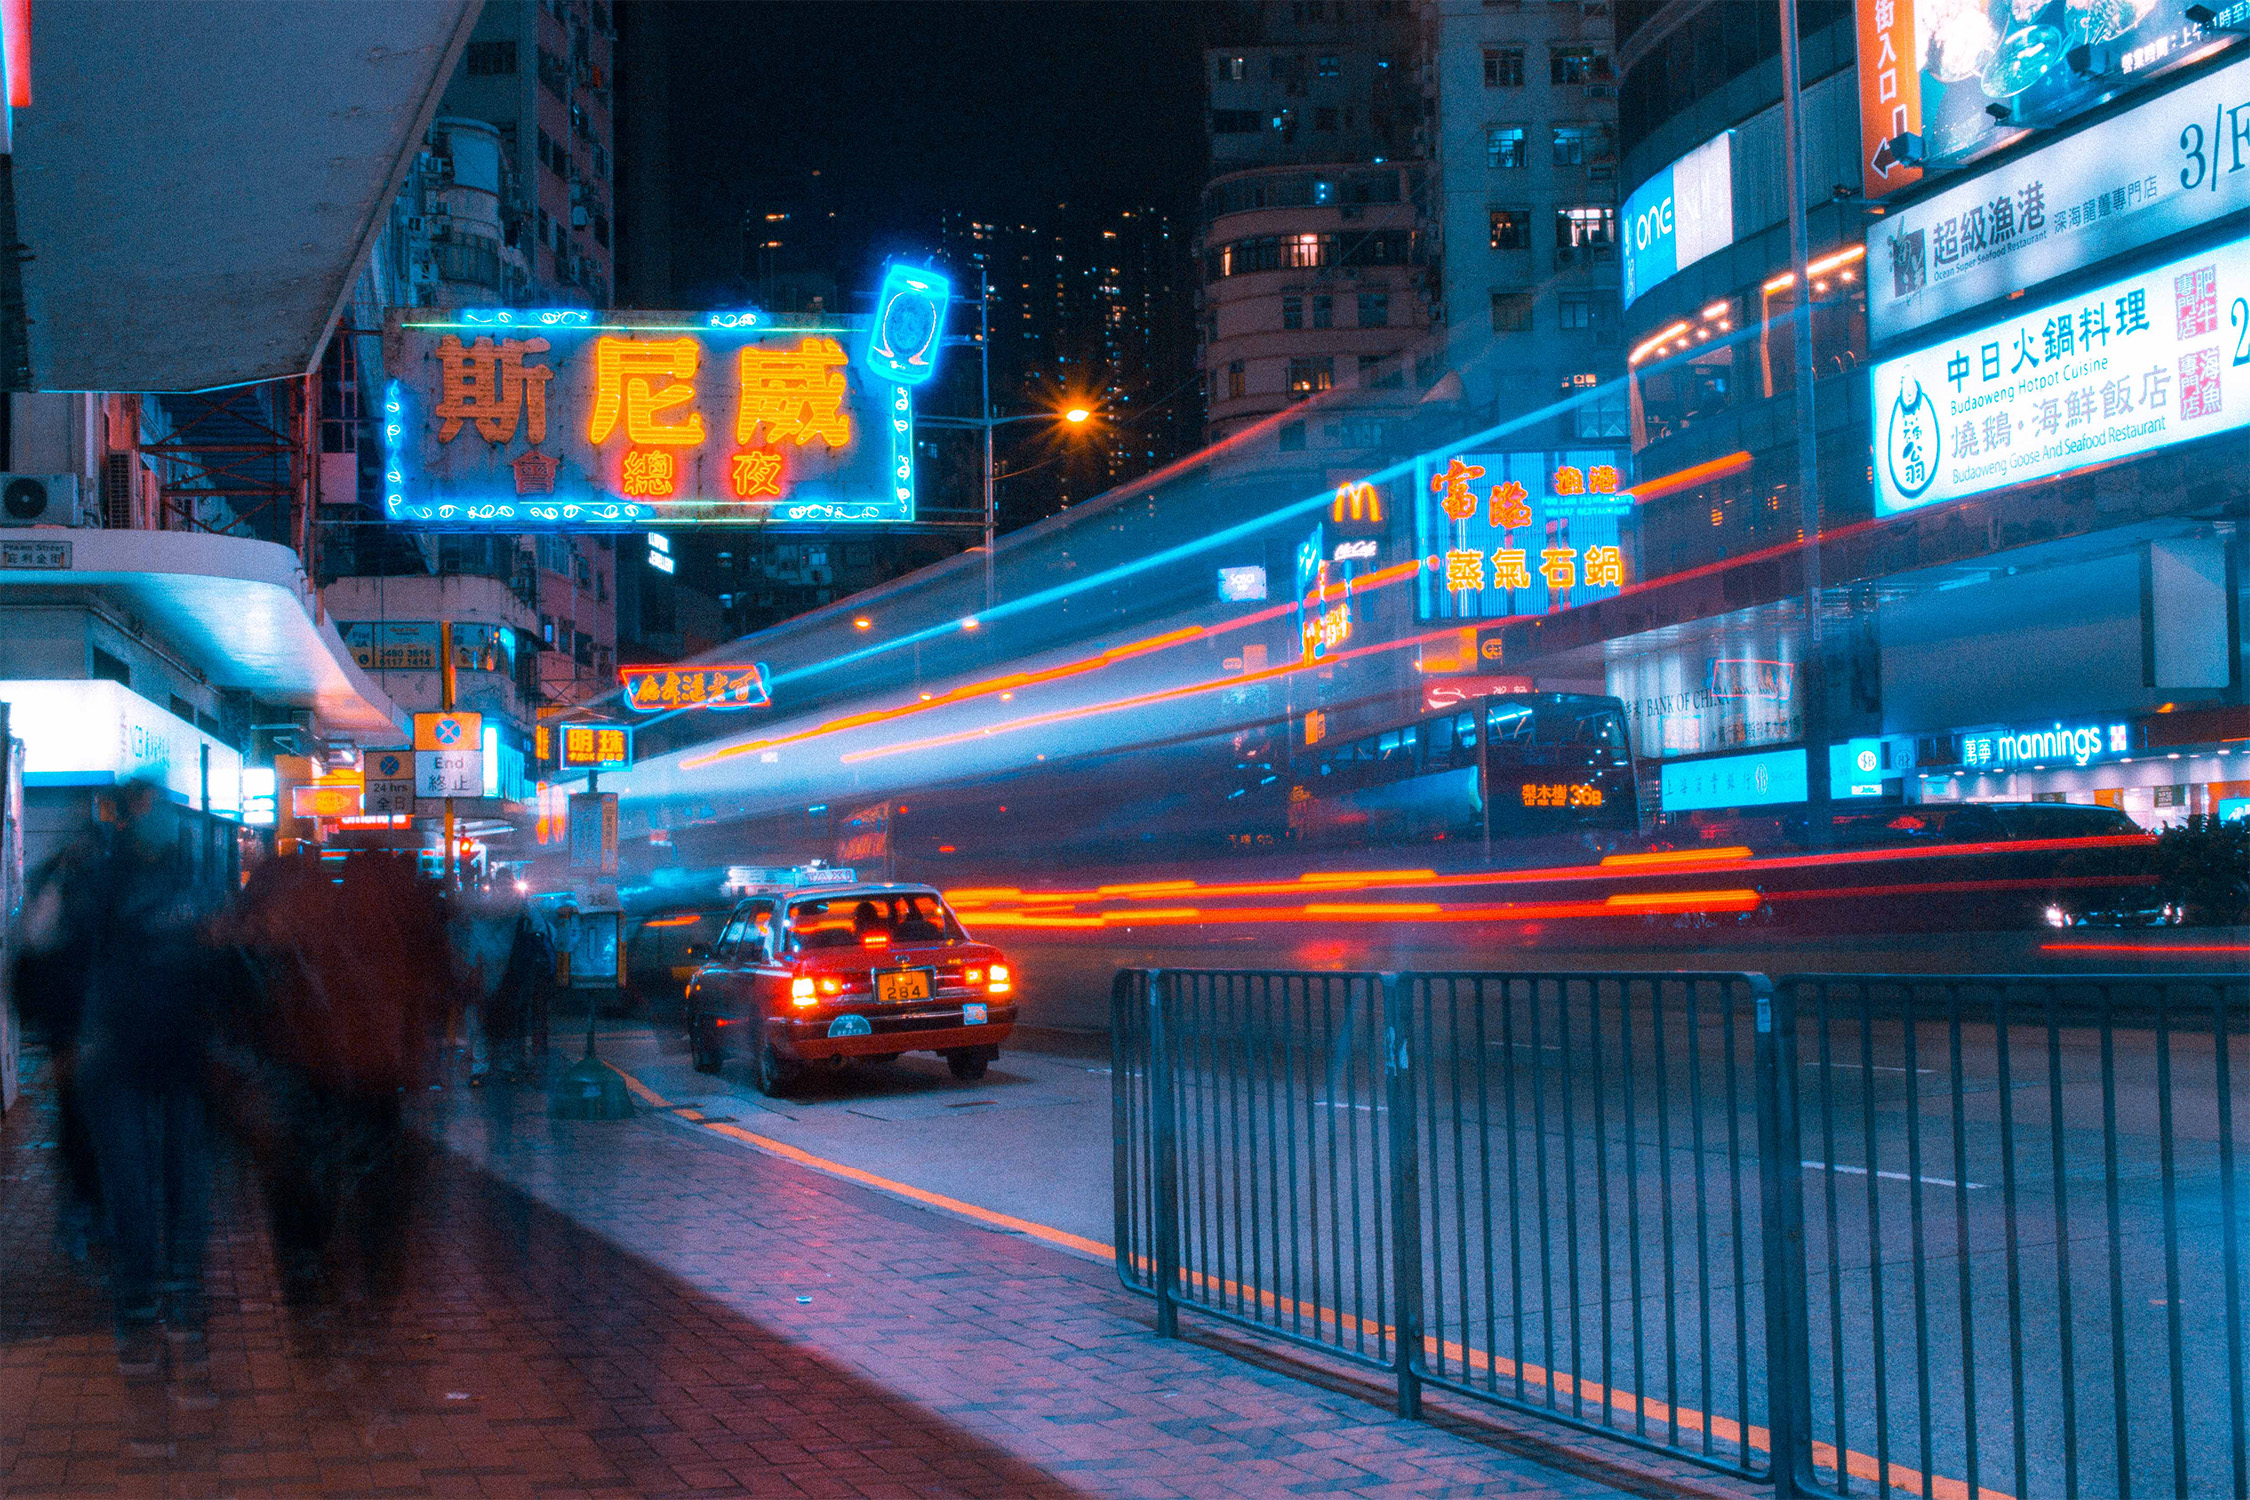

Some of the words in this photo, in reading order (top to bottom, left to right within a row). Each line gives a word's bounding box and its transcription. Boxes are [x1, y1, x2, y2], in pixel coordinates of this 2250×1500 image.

[1933, 180, 2046, 268] 超級漁港
[1933, 265, 1955, 282] Ocean
[1955, 258, 1976, 276] Super
[1977, 246, 2006, 266] Seafood
[2007, 230, 2048, 252] Restaurant
[1947, 288, 2150, 394] 中日火鍋料理
[1950, 385, 2016, 417] Budaoweng
[2018, 370, 2061, 396] Hotpot
[2063, 356, 2110, 382] Cuisine
[1952, 456, 2008, 485] Budaoweng
[2009, 448, 2041, 469] Goose
[2042, 439, 2064, 459] And
[2064, 430, 2108, 456] Seafood
[2108, 414, 2167, 444] Restaurant
[1554, 464, 1618, 496] 漁港
[36, 543, 65, 552] Street
[1445, 544, 1625, 591] 蒸氣石鍋
[352, 631, 370, 639] Flat
[355, 640, 368, 648] 2A
[1646, 695, 1674, 717] BANK
[1676, 692, 1690, 712] OF
[568, 729, 624, 752] 明珠
[1999, 723, 2102, 765] mannings
[434, 757, 465, 769] End
[374, 783, 387, 793] 24
[390, 782, 408, 793] hrs
[428, 774, 470, 792] 終止
[377, 796, 405, 812] 全日
[1569, 784, 1603, 806] 36B
[805, 870, 853, 883] TAXI
[887, 985, 921, 1000] 284
[845, 1021, 854, 1030] 4
